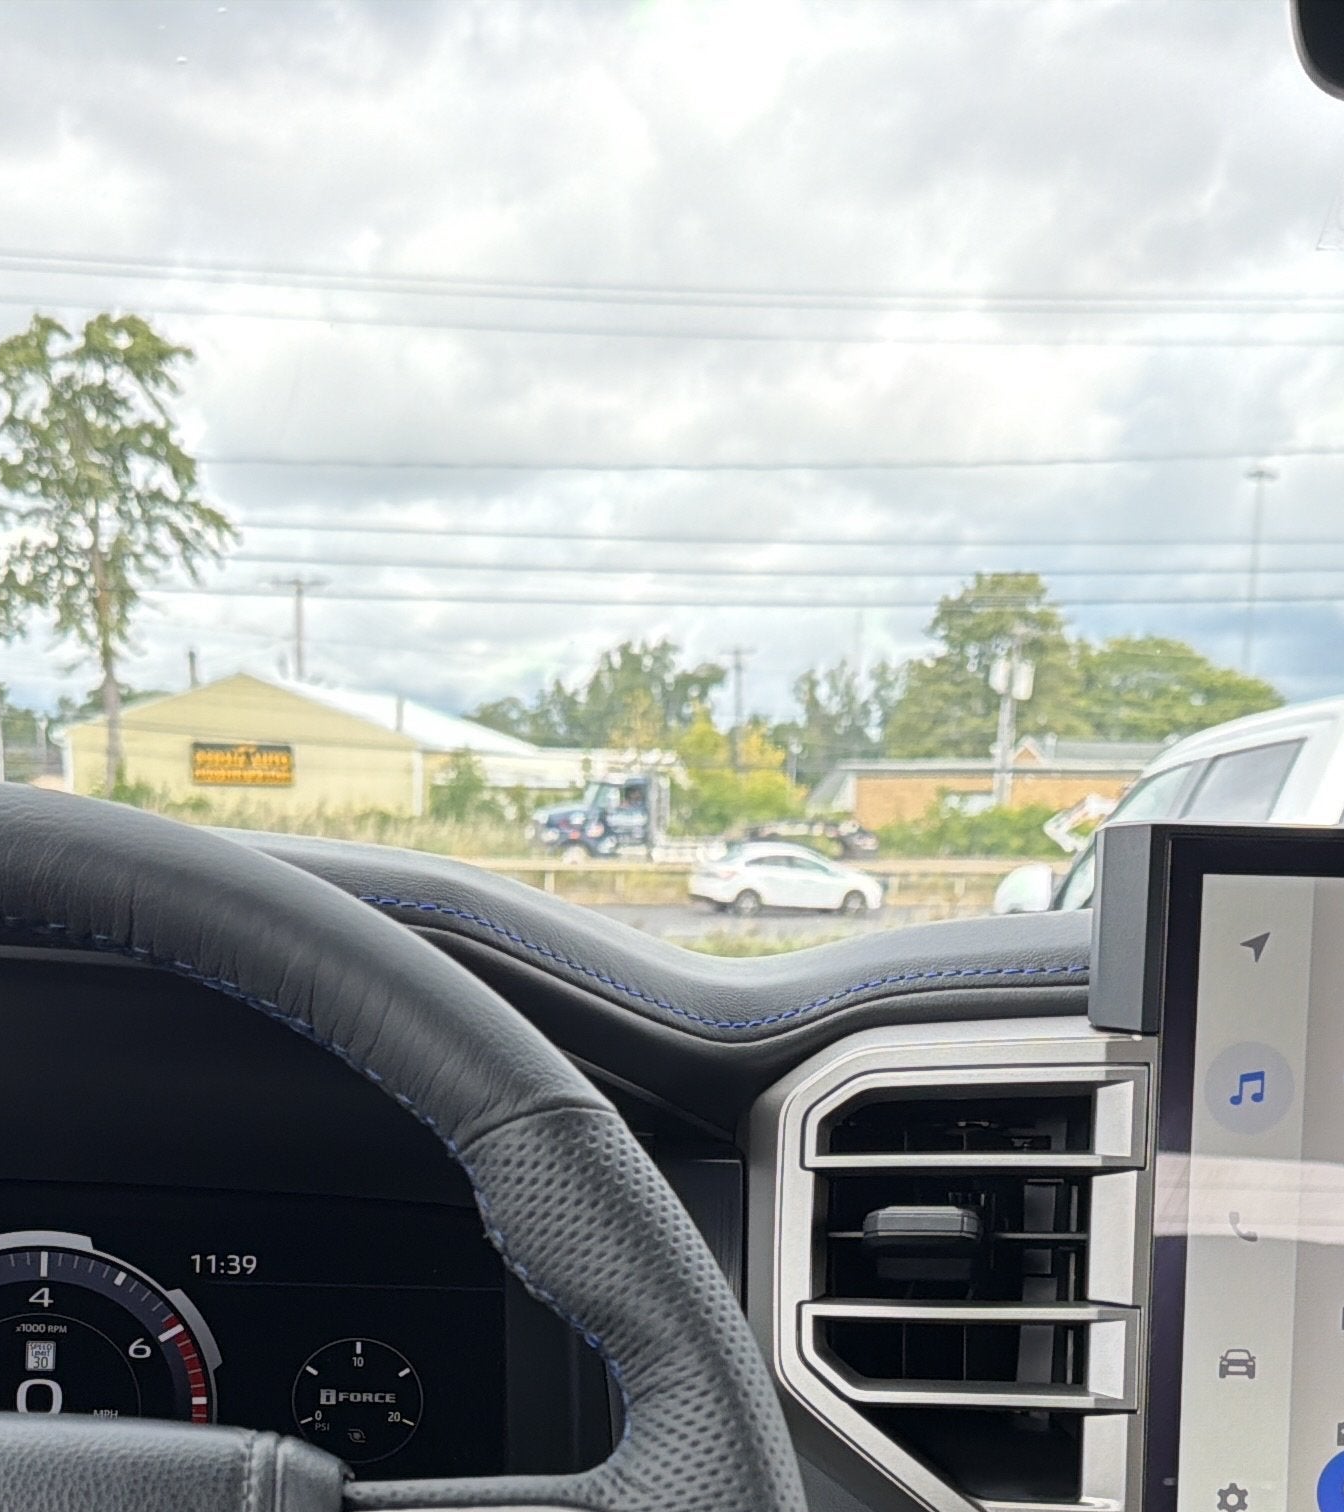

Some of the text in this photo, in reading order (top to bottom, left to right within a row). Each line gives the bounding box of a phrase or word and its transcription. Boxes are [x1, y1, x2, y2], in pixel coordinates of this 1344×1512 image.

[190, 1254, 258, 1276] 11:39
[27, 1286, 55, 1309] 4
[47, 1324, 68, 1334] RPM
[128, 1338, 152, 1359] 6
[32, 1356, 49, 1369] 30
[352, 1357, 365, 1368] 10
[16, 1379, 63, 1414] 0
[387, 1411, 402, 1423] 20
[314, 1422, 331, 1432] PSI
